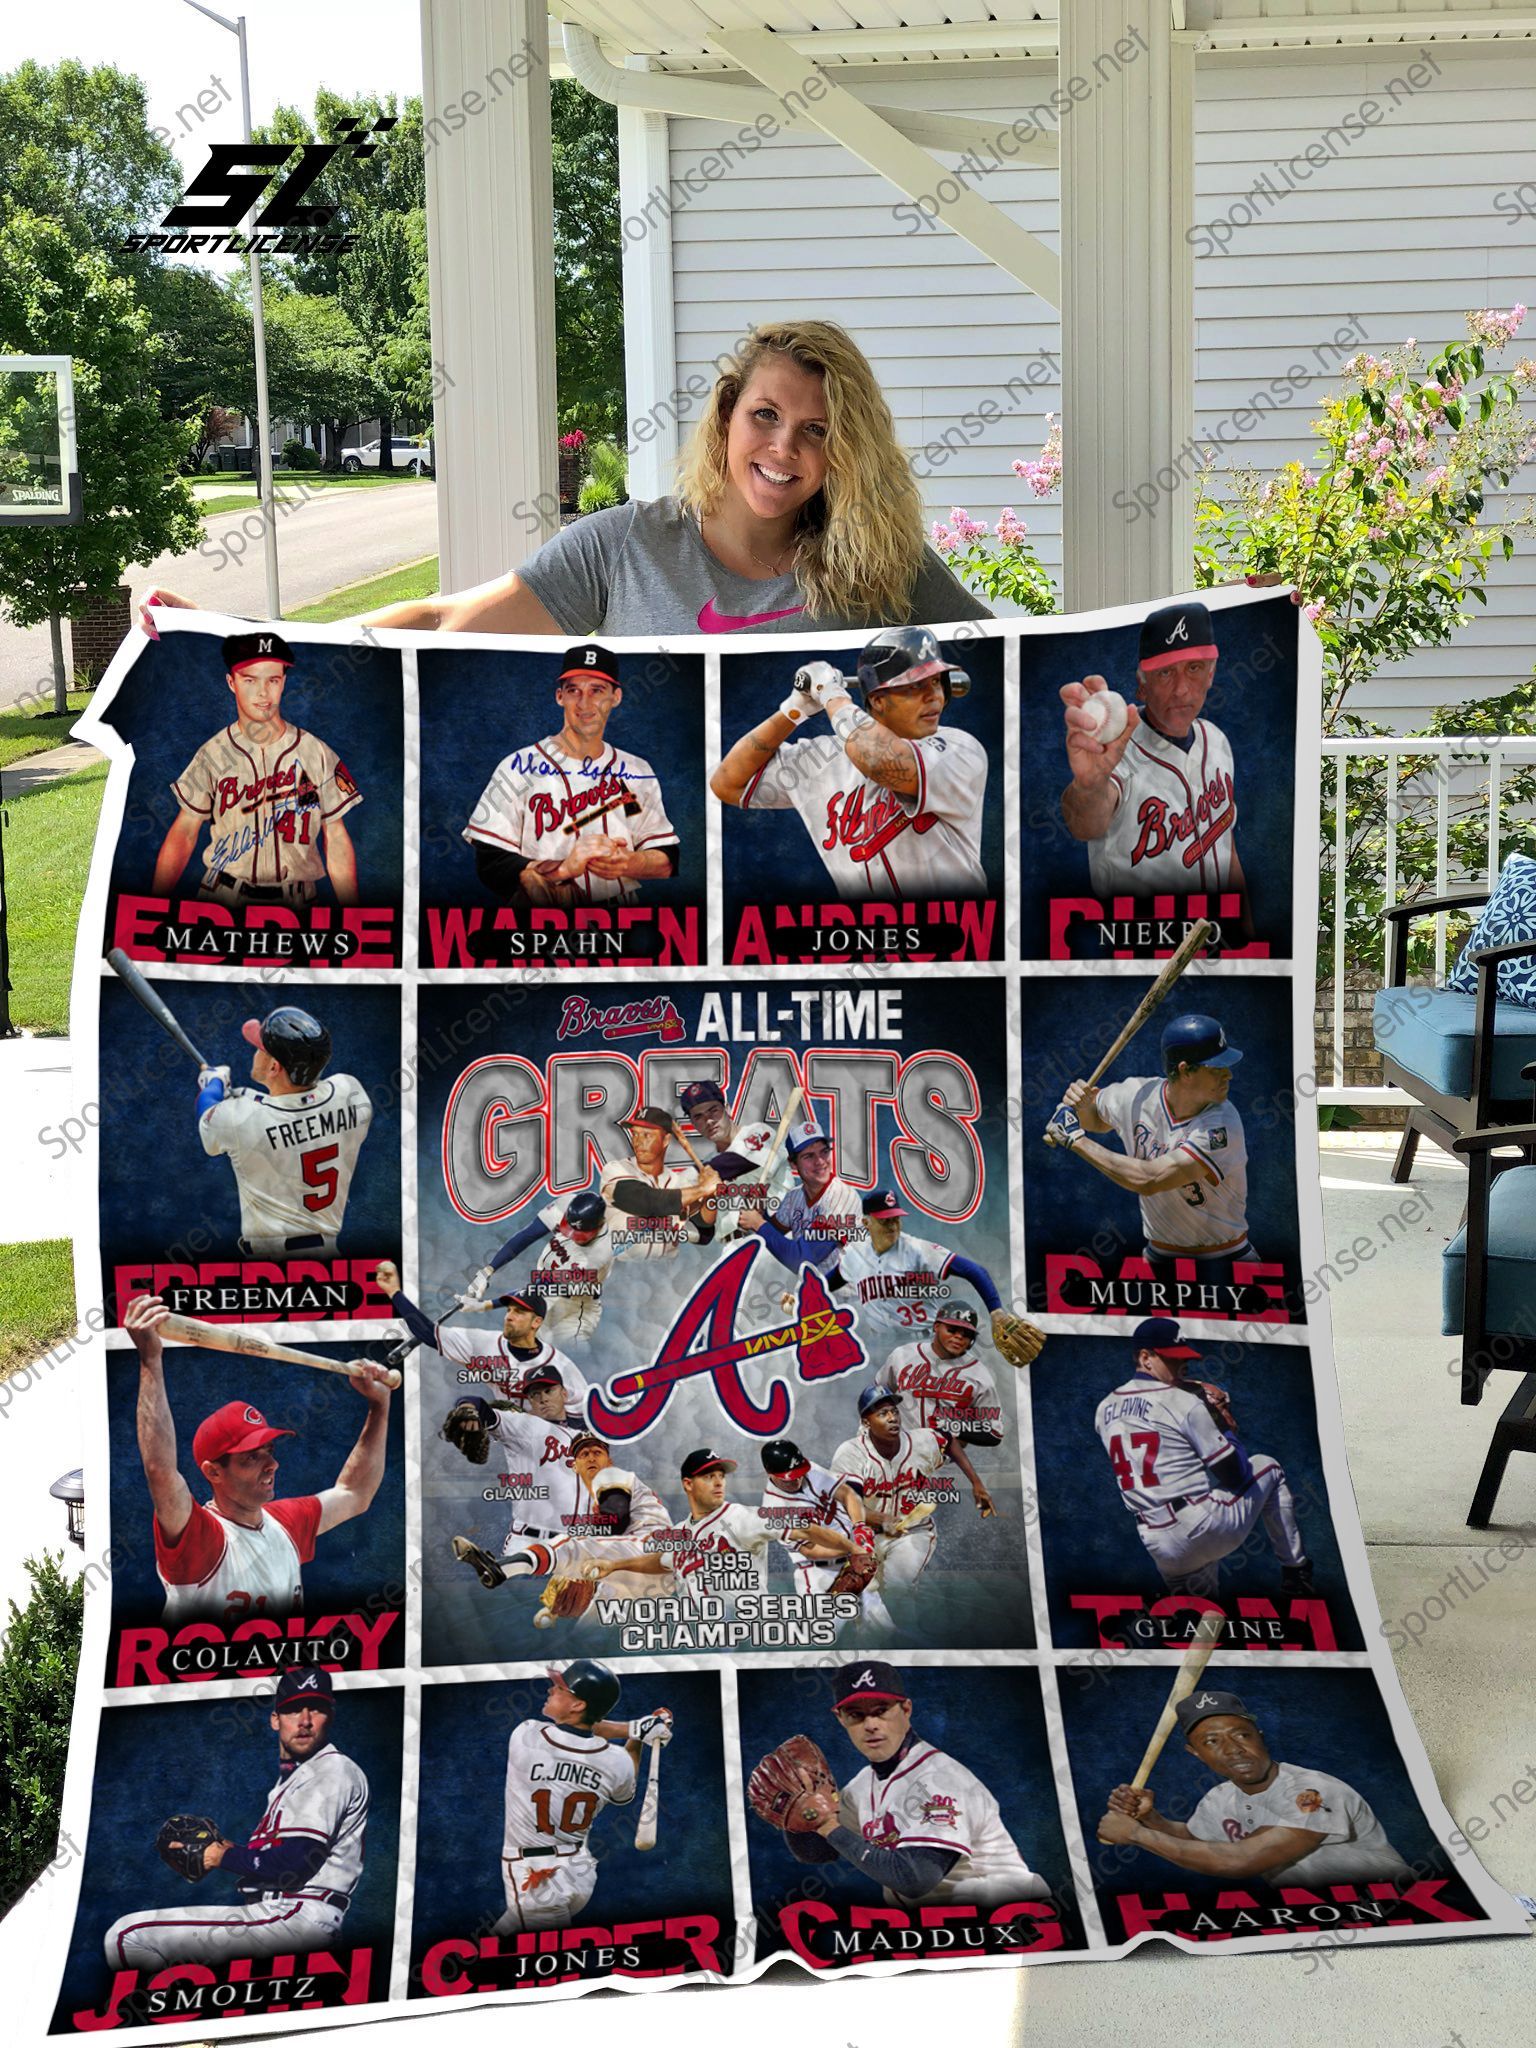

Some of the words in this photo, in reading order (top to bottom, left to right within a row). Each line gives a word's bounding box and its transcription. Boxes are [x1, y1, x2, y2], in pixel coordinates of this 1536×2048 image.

[12, 489, 61, 501] SPALDING
[529, 773, 621, 841] Braves
[277, 811, 311, 845] 41
[165, 926, 349, 956] MATHEWS
[510, 932, 624, 955] SPAHN
[812, 928, 921, 951] JONES
[557, 995, 664, 1041] Braves
[695, 989, 903, 1042] ALL-TIME
[265, 1105, 358, 1150] FREEMAN
[441, 1047, 985, 1225] GREATS
[301, 1143, 339, 1213] 5
[716, 1183, 770, 1198] ROCKY
[705, 1198, 782, 1211] COLAVITO
[626, 1216, 673, 1231] EDDIE
[814, 1215, 857, 1229] DALE
[612, 1230, 689, 1245] MATHEWS
[803, 1229, 869, 1243] MURPHY
[530, 1269, 599, 1284] FREDDIE
[906, 1272, 939, 1286] PHIL
[172, 1285, 349, 1311] FREEMAN
[527, 1283, 602, 1298] FREEMAN
[893, 1285, 951, 1300] NIEKRO
[1090, 1280, 1247, 1311] MURPHY
[897, 1301, 928, 1326] 35
[465, 1356, 510, 1370] JOHN
[457, 1369, 520, 1384] SMOLTZ
[932, 1406, 1001, 1421] ANDRUW
[1103, 1396, 1153, 1426] GLAVINE
[941, 1420, 993, 1435] JONES
[1108, 1431, 1161, 1491] 47
[497, 1472, 533, 1487] TOM
[909, 1476, 955, 1491] HANK
[483, 1485, 549, 1501] GLAVINE
[905, 1490, 961, 1505] AARON
[560, 1514, 619, 1527] WARREN
[764, 1518, 811, 1531] JONES
[567, 1525, 613, 1538] SPAHN
[653, 1528, 692, 1541] GREG
[643, 1540, 703, 1553] MADDUX
[702, 1551, 752, 1572] 1995
[695, 1571, 760, 1592] 1-TIME
[597, 1595, 726, 1627] WORLD
[735, 1593, 859, 1622] SERIES
[1070, 1595, 1340, 1652] TOM
[1134, 1618, 1285, 1640] GLAVINE
[620, 1620, 837, 1652] CHAMPIONS
[171, 1638, 349, 1671] COLAVITO
[530, 1762, 602, 1790] C.JONES
[530, 1787, 600, 1836] 10
[1192, 1900, 1385, 1933] AARON
[832, 1925, 1020, 1957] MADDUX
[515, 1945, 641, 1979] JONES
[147, 1975, 317, 2014] SMOLTZ
